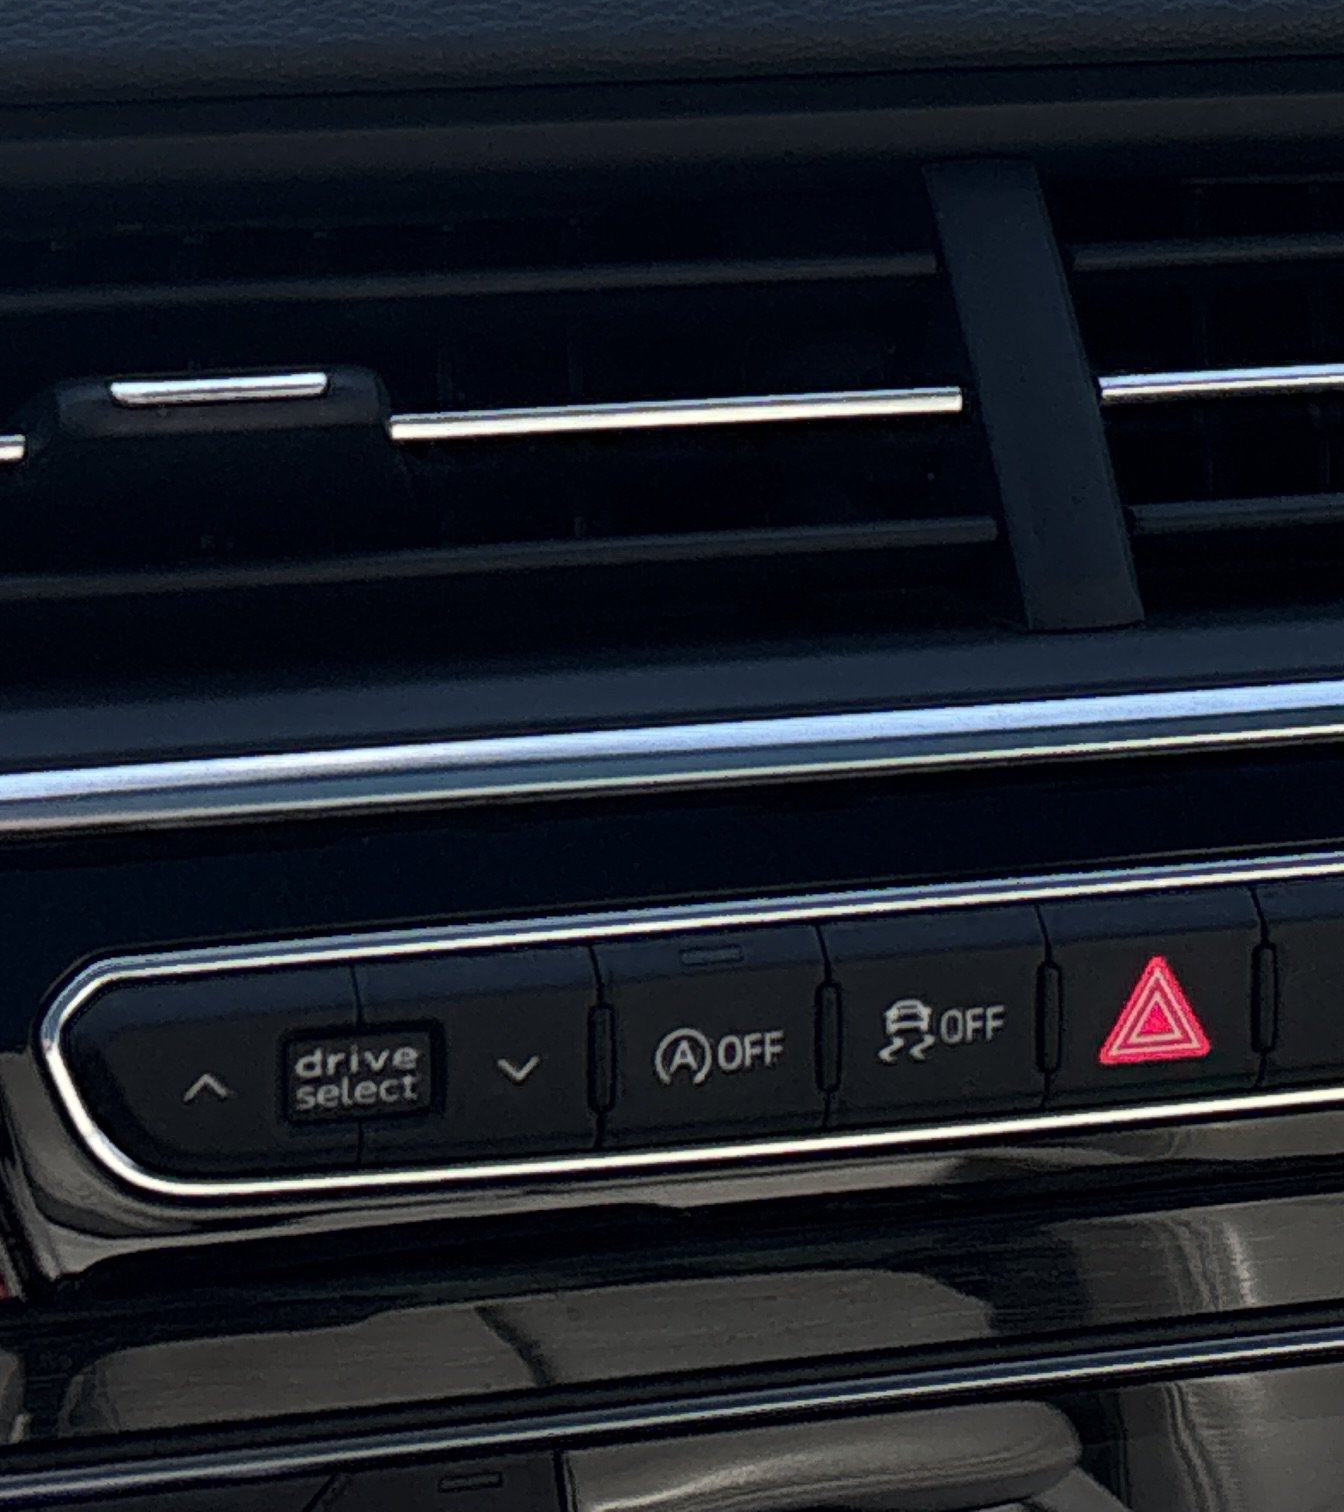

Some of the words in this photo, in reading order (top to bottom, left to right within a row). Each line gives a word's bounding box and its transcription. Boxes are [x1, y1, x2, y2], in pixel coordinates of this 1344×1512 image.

[941, 1007, 1003, 1042] OFF
[295, 1046, 417, 1079] drive
[718, 1031, 783, 1069] OFF
[296, 1075, 417, 1108] select
